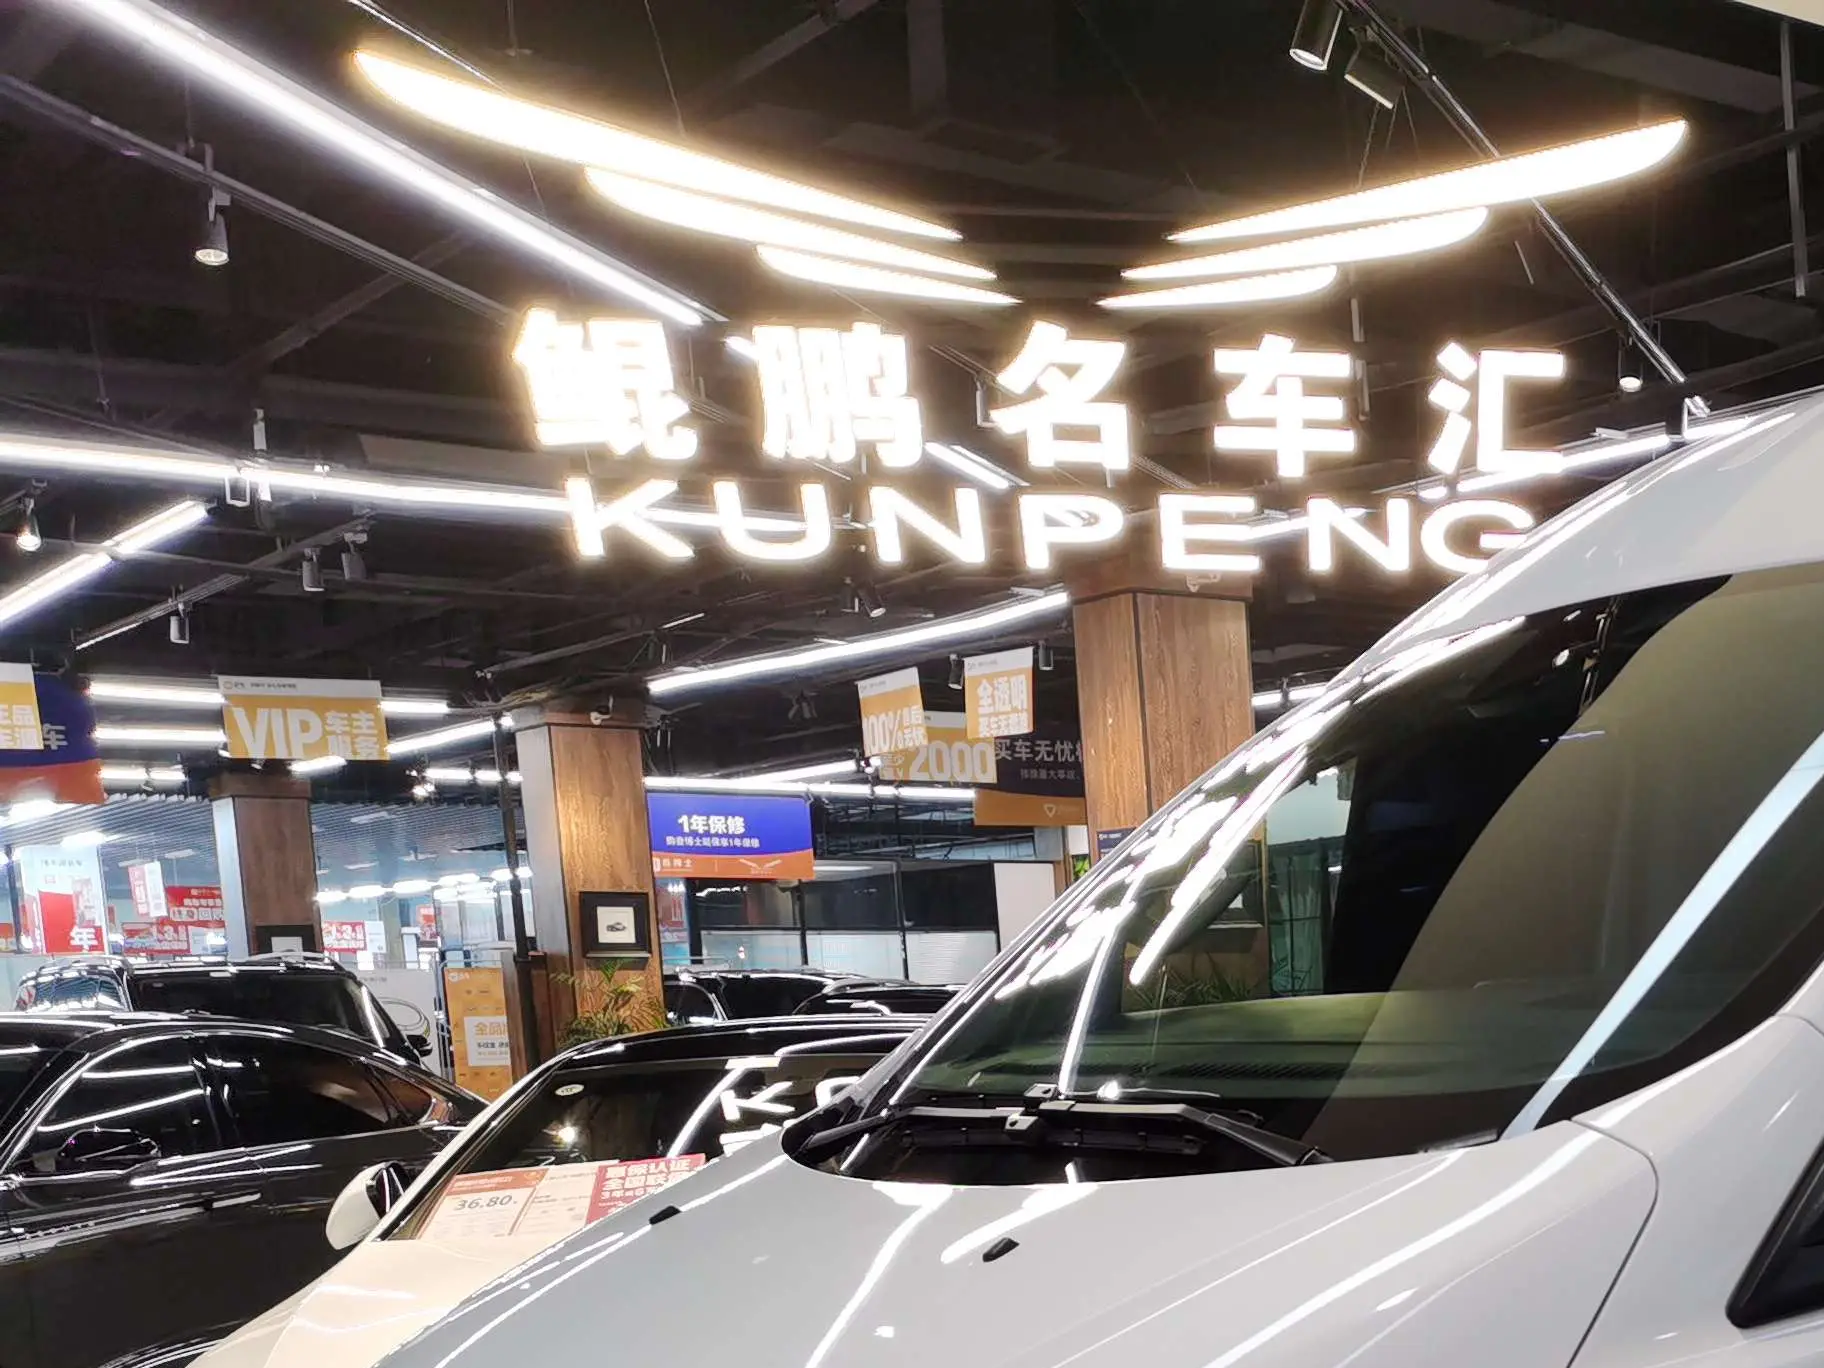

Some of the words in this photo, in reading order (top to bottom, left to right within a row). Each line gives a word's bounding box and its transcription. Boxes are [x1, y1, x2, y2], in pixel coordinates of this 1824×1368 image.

[511, 306, 1566, 479] 鲲鹏名车汇
[562, 474, 1538, 575] KUNPENG
[232, 707, 323, 759] VIP
[995, 738, 1083, 762] 买车无忧
[677, 814, 746, 834] 1年保修
